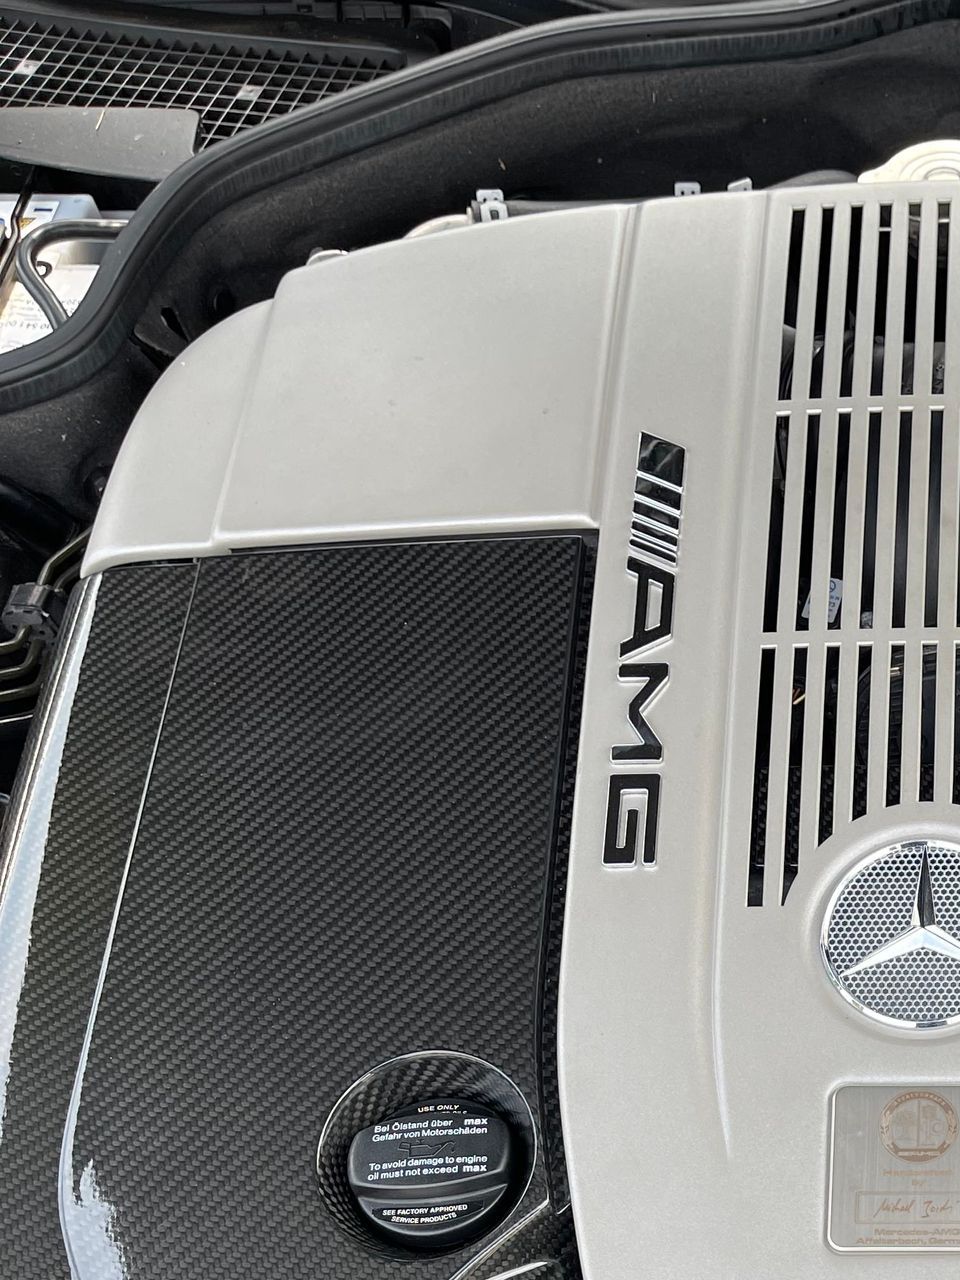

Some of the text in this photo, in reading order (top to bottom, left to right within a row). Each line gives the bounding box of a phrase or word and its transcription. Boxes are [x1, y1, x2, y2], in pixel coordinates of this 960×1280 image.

[602, 556, 677, 869] AMG
[417, 1105, 435, 1113] USE
[391, 1120, 429, 1131] Ölstand
[430, 1119, 453, 1128] über
[464, 1117, 488, 1126] max
[372, 1132, 402, 1142] Gefahr
[421, 1126, 488, 1137] Motorschäden
[369, 1154, 488, 1171] To avoid damage to engine
[367, 1164, 487, 1181] oil must not exceed max
[382, 1208, 397, 1216] SEE
[397, 1207, 429, 1216] FACTORY
[391, 1212, 458, 1224] SERVICE PRODUCTS
